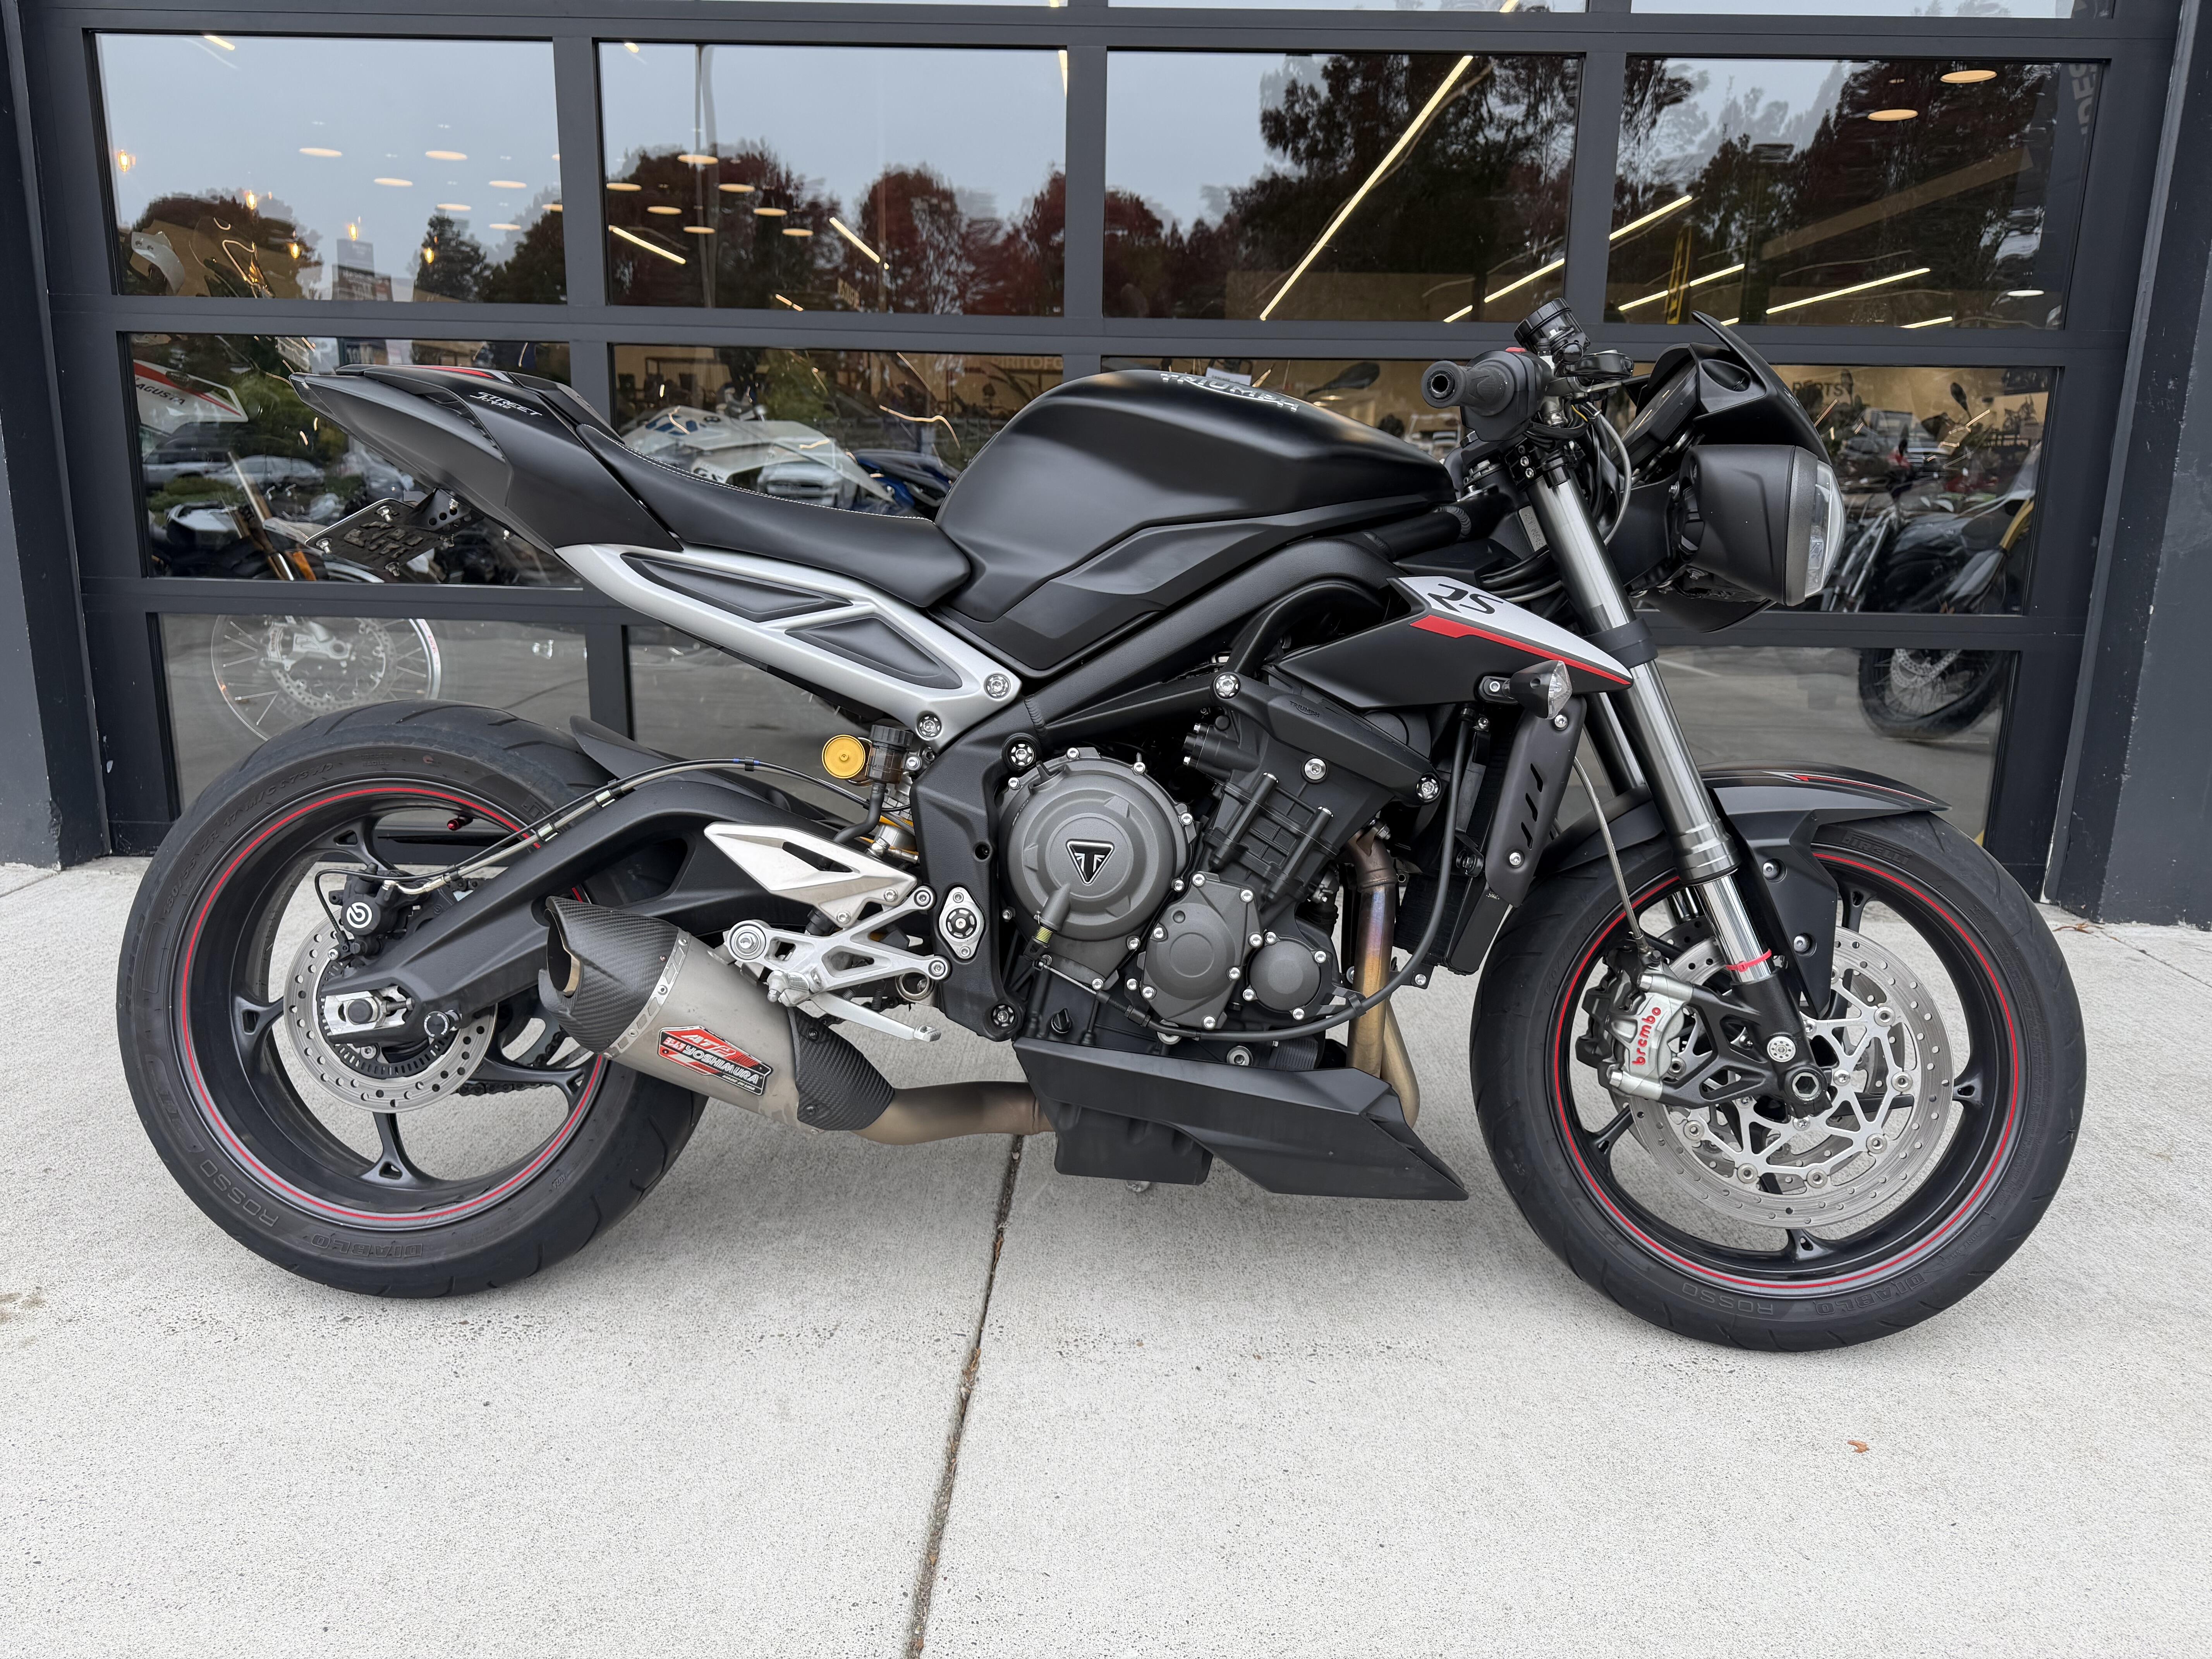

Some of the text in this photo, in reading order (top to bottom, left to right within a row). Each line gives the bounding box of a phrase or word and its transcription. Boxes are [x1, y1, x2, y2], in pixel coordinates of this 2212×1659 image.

[136, 383, 185, 405] AGUSTA
[470, 392, 543, 416] STREET
[1160, 373, 1299, 412] TRIUMPH
[1427, 584, 1504, 615] RS
[160, 854, 198, 918] 180/55
[196, 827, 222, 856] ZR
[221, 806, 243, 829] 17
[1839, 829, 1913, 867] PIRELLI
[1632, 1007, 1661, 1066] brembo
[682, 1044, 759, 1084] YOSHIMURA
[198, 1154, 280, 1231] ROSSO
[309, 1226, 424, 1263] DIABLO
[1679, 1280, 1774, 1315] ROSSO
[1813, 1268, 1928, 1319] DIABLO
